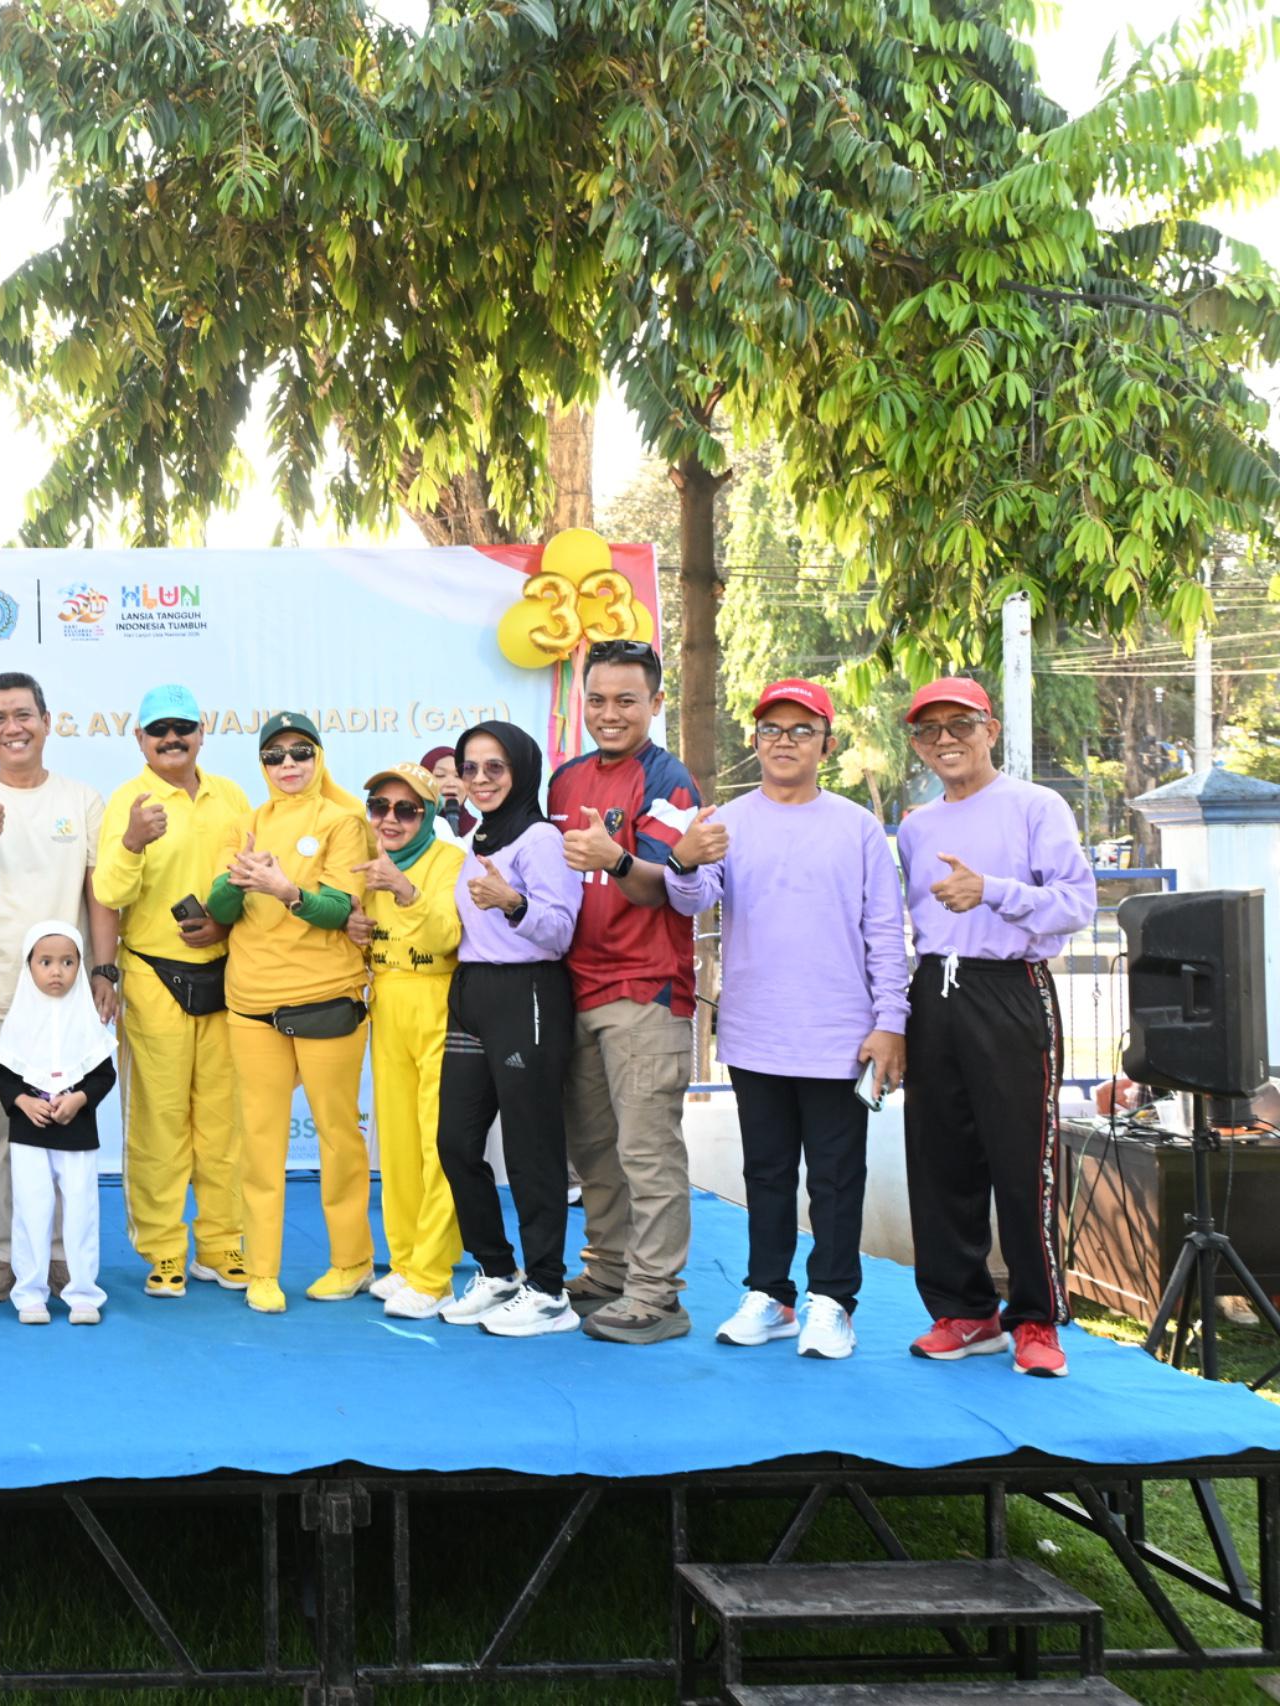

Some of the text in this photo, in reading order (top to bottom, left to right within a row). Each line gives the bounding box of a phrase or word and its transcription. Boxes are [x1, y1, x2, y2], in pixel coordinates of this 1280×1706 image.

[121, 584, 200, 609] HLUN
[121, 611, 201, 620] LANSIA TANGGUH
[116, 622, 207, 631] INDONESIA TUMBUH
[55, 711, 80, 736] &
